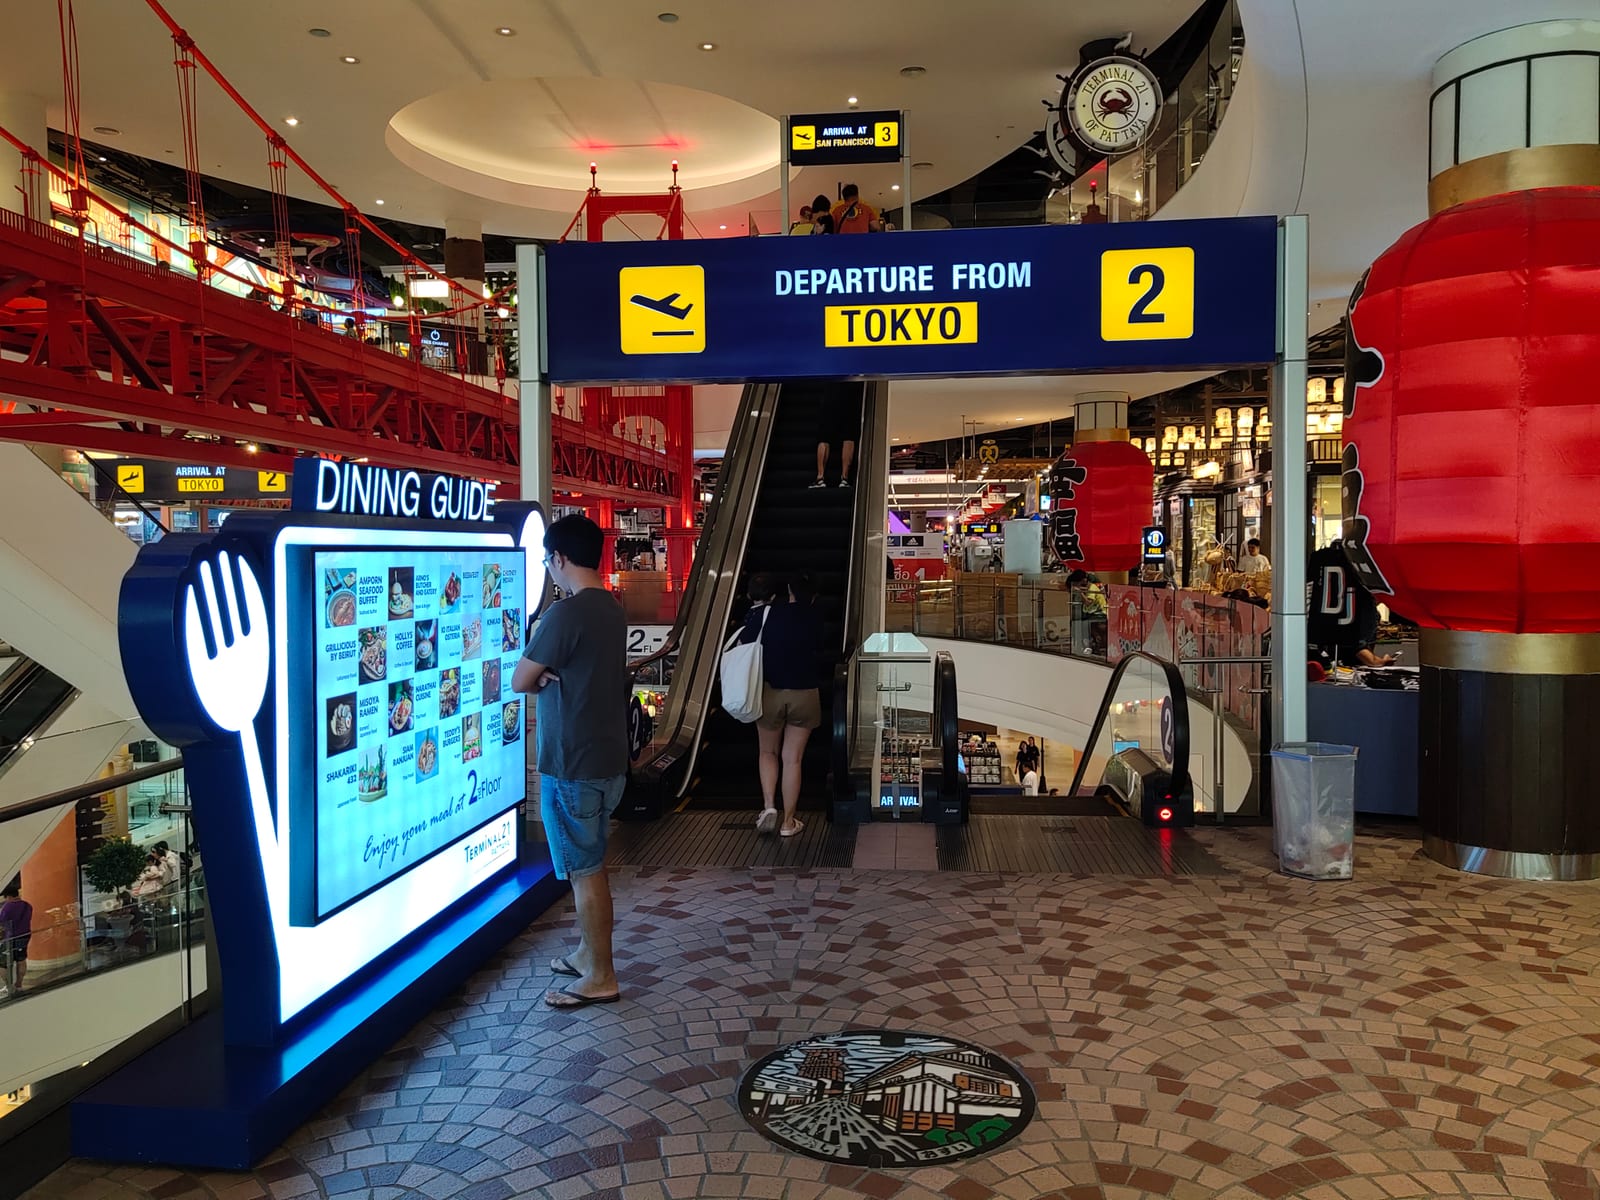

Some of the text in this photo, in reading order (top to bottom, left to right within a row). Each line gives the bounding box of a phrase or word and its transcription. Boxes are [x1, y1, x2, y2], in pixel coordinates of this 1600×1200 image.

[1082, 67, 1149, 94] TERMINAL 21
[823, 126, 868, 136] ARRIVAL AT
[882, 126, 891, 142] 3
[1085, 118, 1148, 143] OF PATTAYA
[816, 137, 874, 148] SAN FRANCISCO
[775, 262, 1031, 296] DEPARTURE FROM
[1127, 263, 1166, 325] 2
[841, 306, 961, 343] TOKYO
[176, 466, 226, 476] ARRIVAL AT
[183, 479, 219, 490] TOKYO
[266, 472, 277, 486] 2
[316, 459, 497, 522] DINING GUIDE
[359, 576, 383, 585] AMPORN
[359, 585, 384, 595] SEAFOOD
[359, 595, 378, 605] BUFFET
[395, 631, 413, 641] HOLLYS
[325, 640, 357, 653] GRILLICIOUS
[396, 640, 413, 650] COFFEE
[331, 649, 356, 661] BY BEIRUT
[360, 696, 380, 707] MISOYA
[360, 706, 379, 718] RAMEN
[444, 726, 460, 738] TEDDY'S
[632, 707, 640, 751] 2
[1164, 708, 1172, 754] 2
[443, 735, 461, 748] BURGERS
[402, 744, 414, 754] SIAM
[326, 763, 357, 783] SHAKARIKI
[881, 796, 920, 806] ARIVAL
[363, 769, 502, 870] Enjoy your meal at 2 Floor
